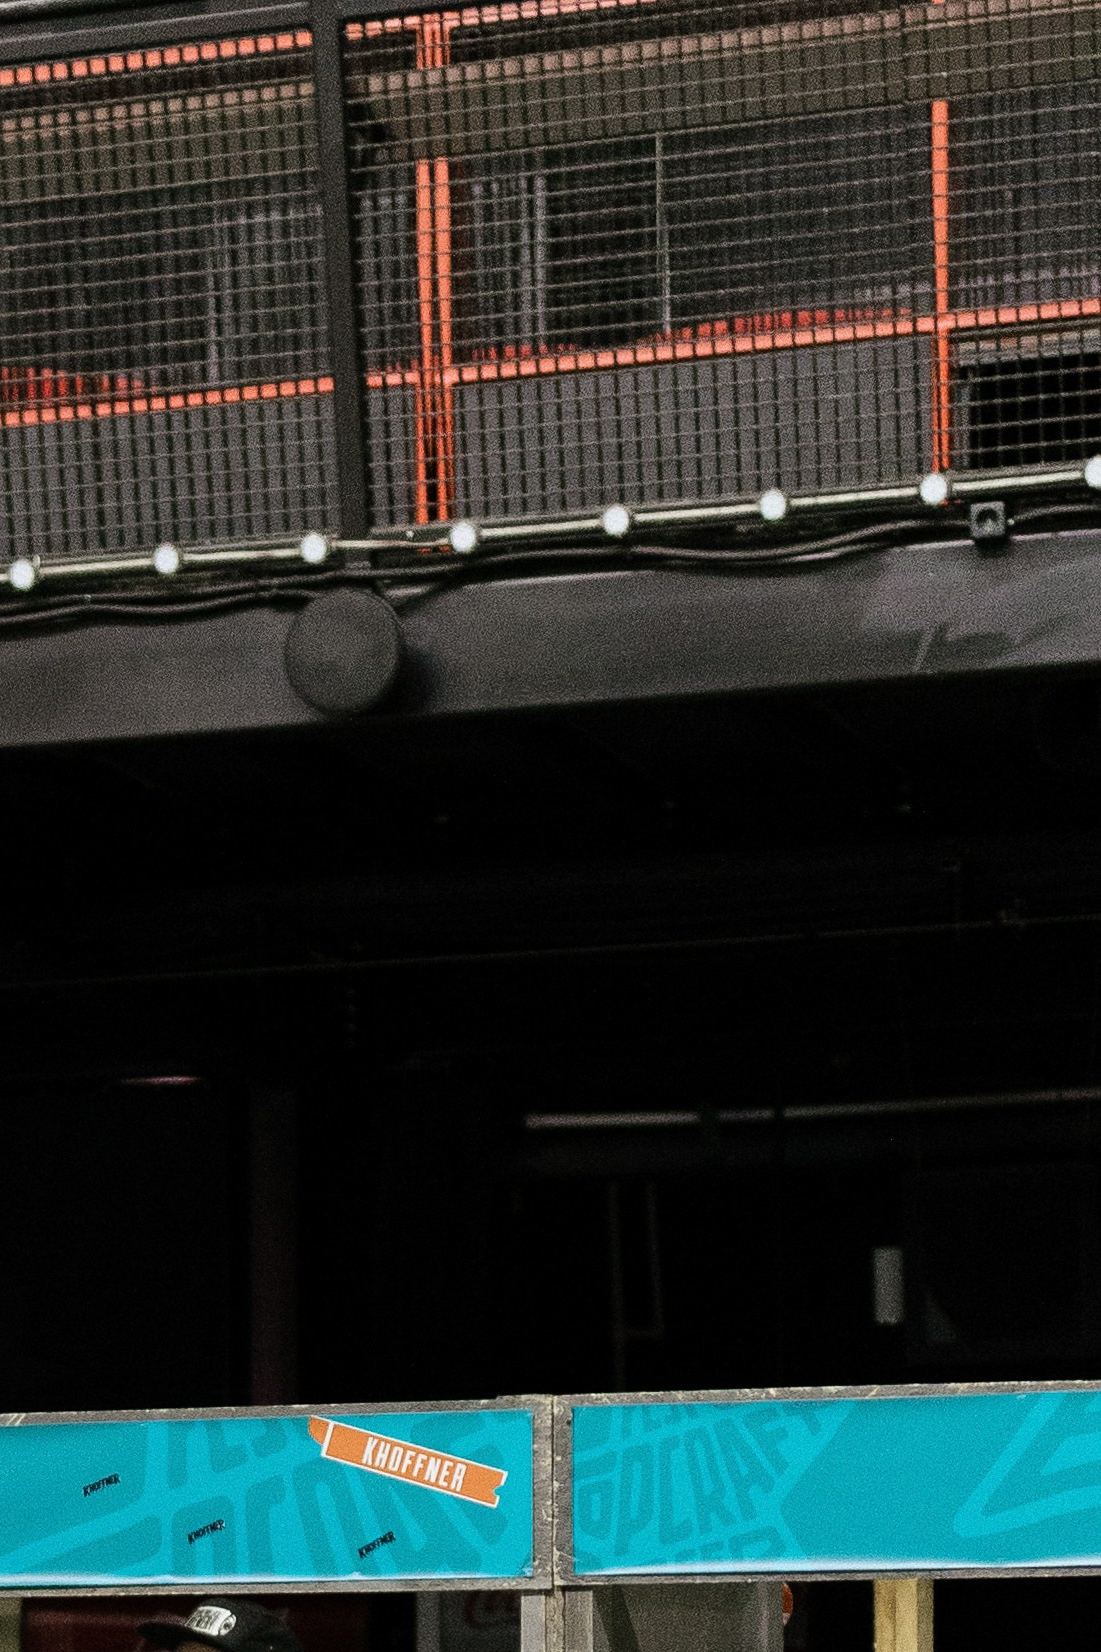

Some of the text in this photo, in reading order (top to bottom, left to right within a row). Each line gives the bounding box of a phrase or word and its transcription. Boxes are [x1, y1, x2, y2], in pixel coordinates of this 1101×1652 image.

[361, 1435, 467, 1493] KHOFFNER
[82, 1473, 121, 1499] KHOFFNER
[187, 1518, 226, 1545] KHOFFNER
[357, 1531, 397, 1559] KHOFFNER
